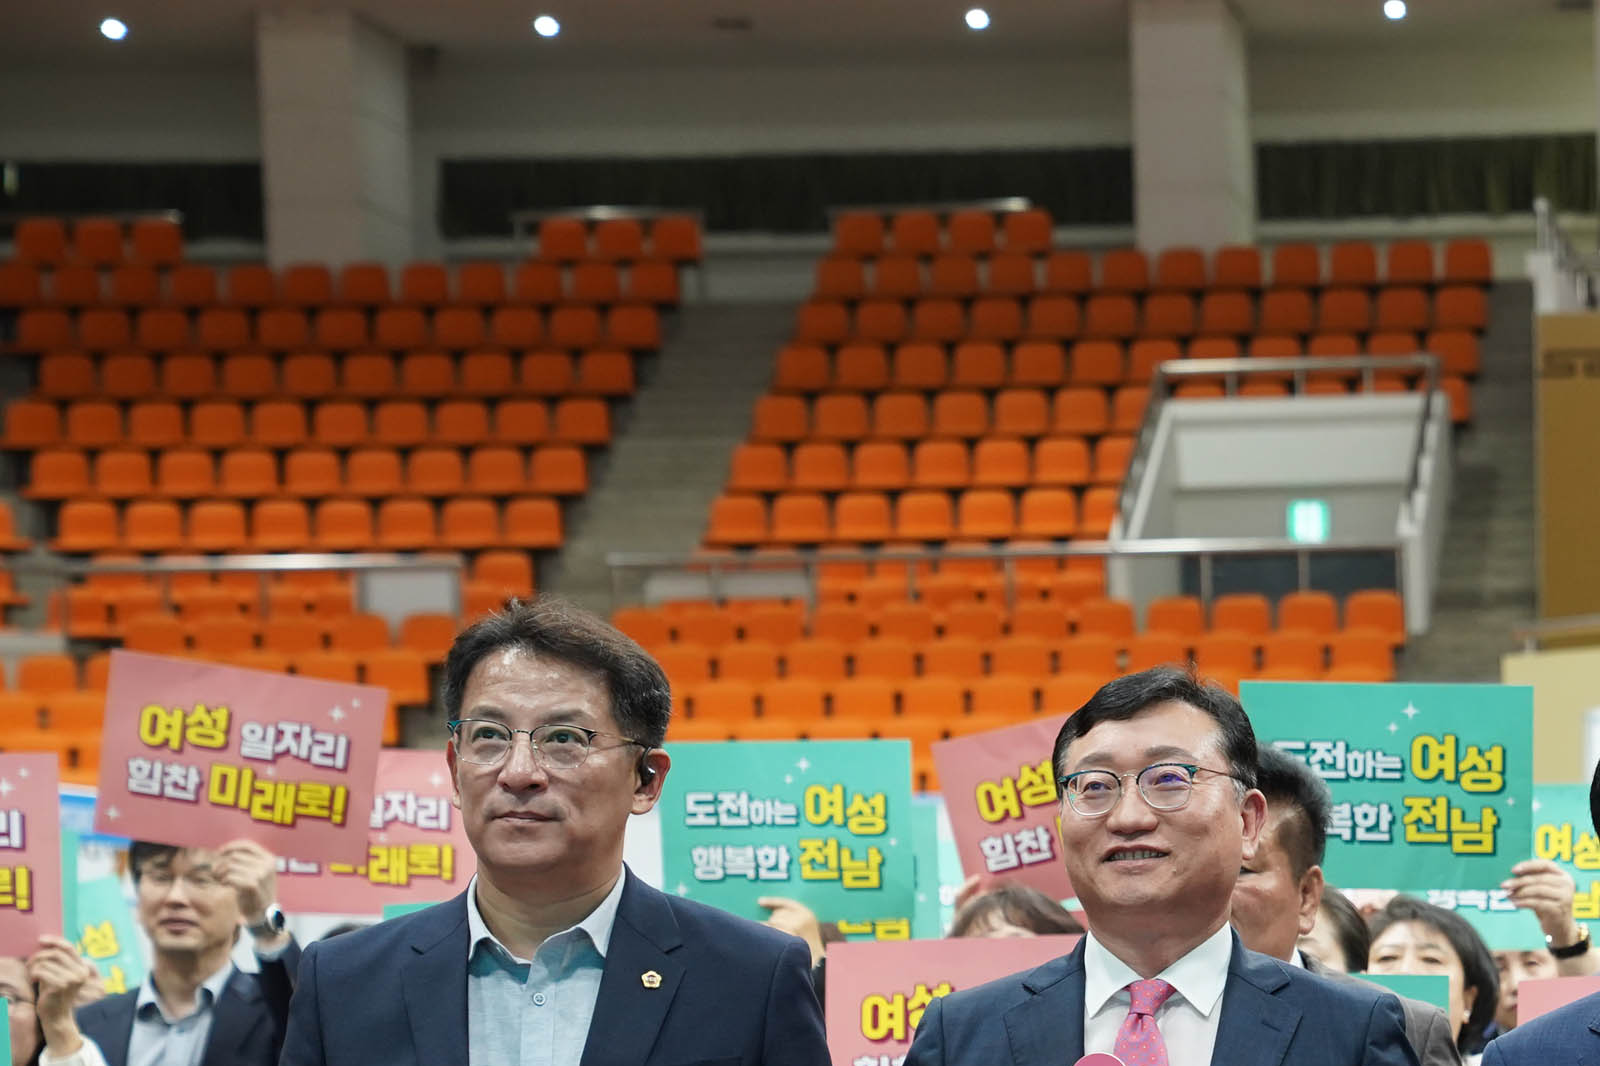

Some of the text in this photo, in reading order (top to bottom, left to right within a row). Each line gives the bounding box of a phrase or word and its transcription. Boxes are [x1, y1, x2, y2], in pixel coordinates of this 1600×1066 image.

[138, 703, 350, 770] 여성 일자리
[1410, 733, 1506, 794] 여성
[127, 756, 349, 826] 힘찬 미래로!
[684, 783, 888, 835] 도전하는 여성
[975, 759, 1058, 823] 여성
[979, 825, 1056, 874] 힘찬
[1325, 796, 1500, 855] 복한 전남
[691, 837, 884, 890] 행복한 전남
